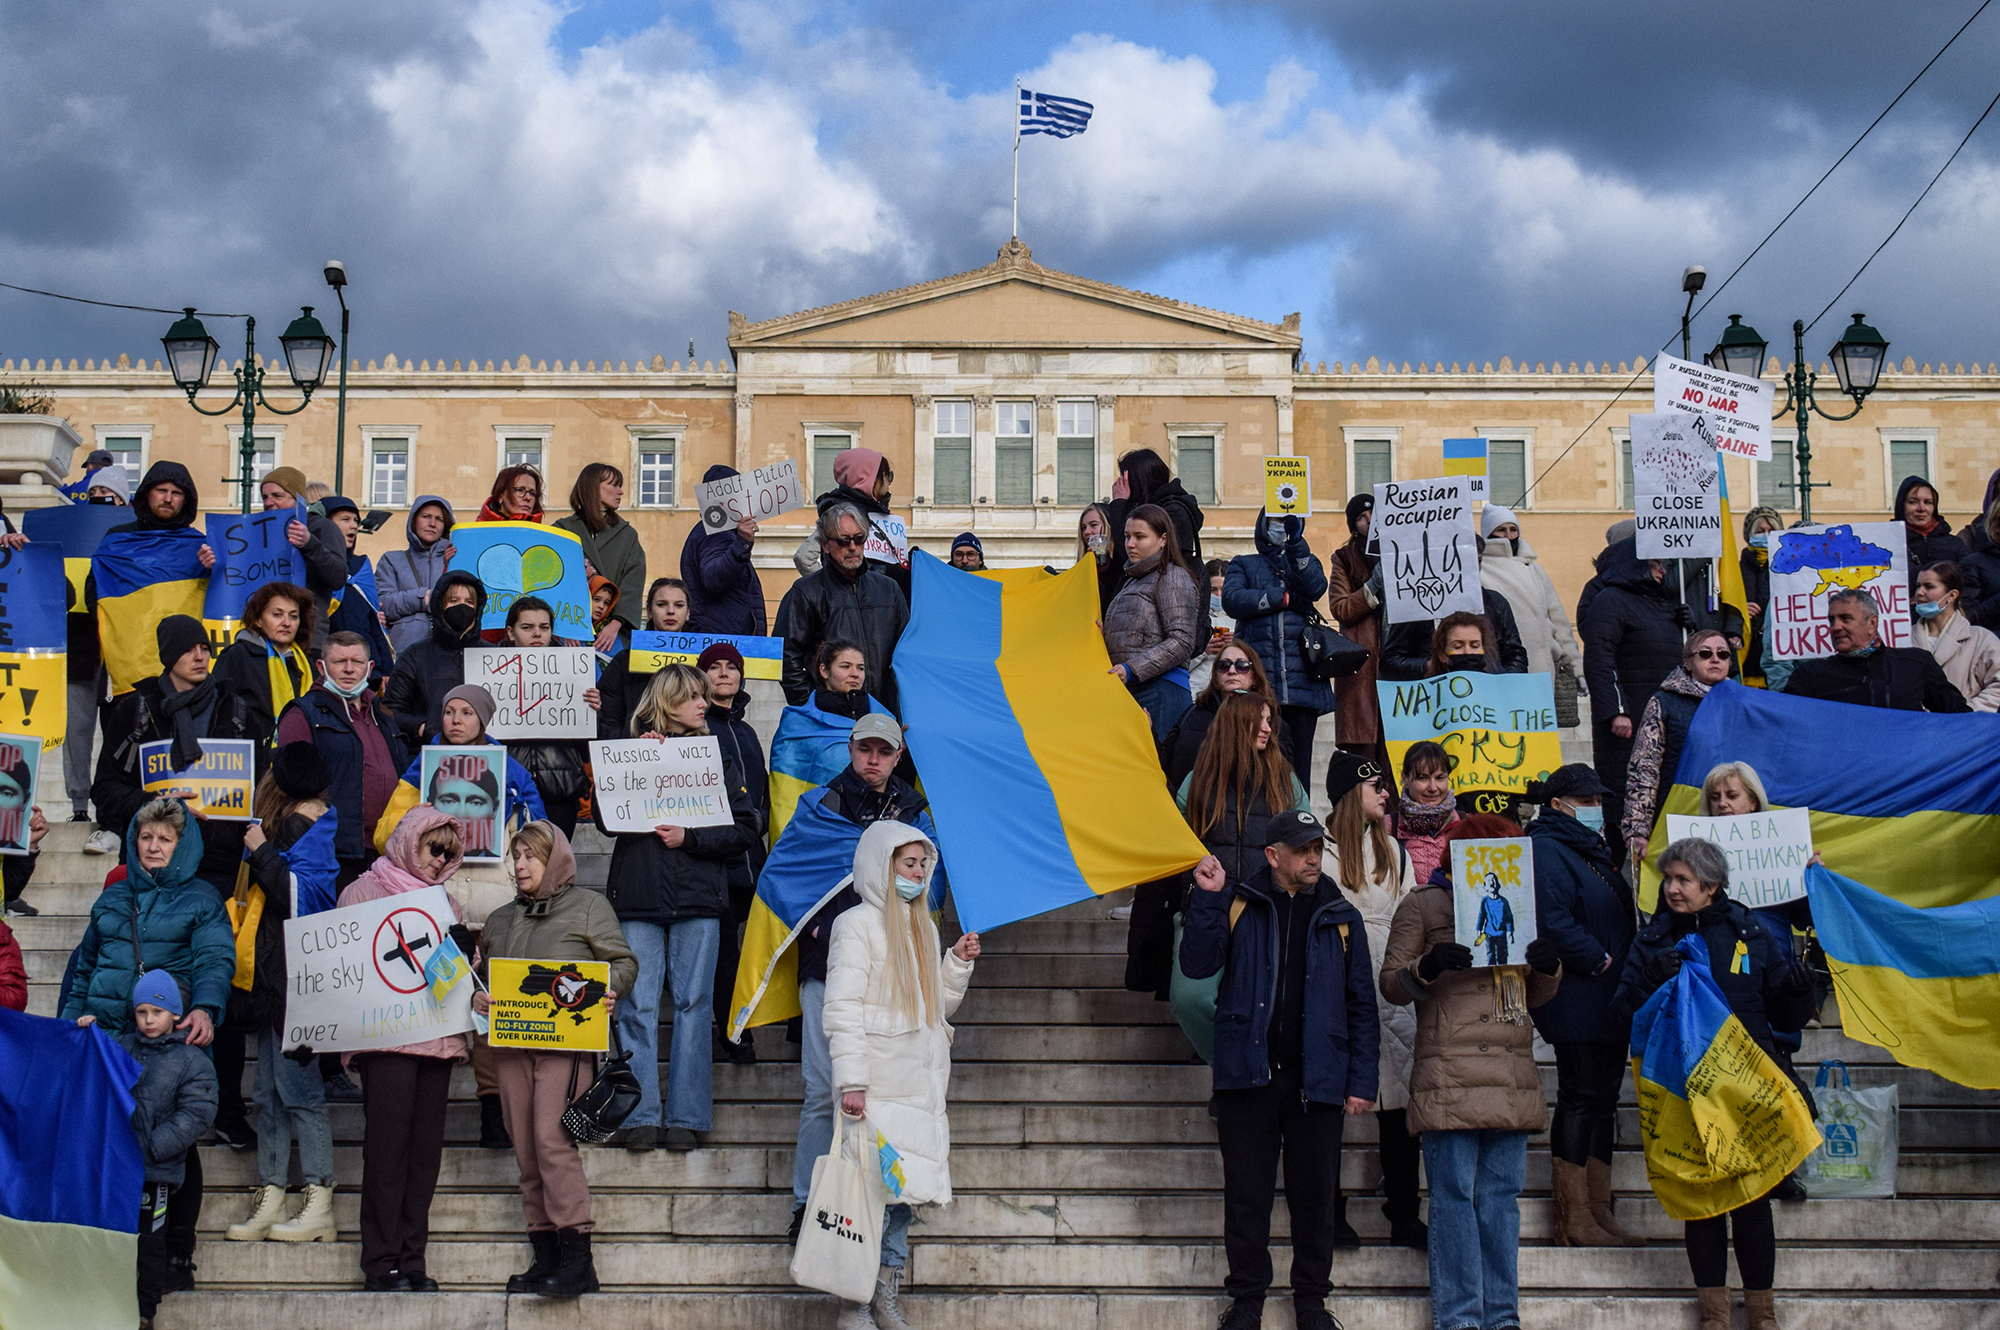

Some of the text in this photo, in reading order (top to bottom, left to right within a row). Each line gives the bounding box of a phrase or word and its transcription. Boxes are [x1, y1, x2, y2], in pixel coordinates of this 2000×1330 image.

[1678, 365, 1702, 378] RUSSIA
[1703, 373, 1725, 385] STOPS
[1726, 379, 1759, 394] FIGHTING
[1689, 378, 1739, 397] THERE WILL BE
[1682, 387, 1738, 414] NO WAR
[1728, 416, 1760, 431] FIGHTING
[1716, 435, 1759, 457] RAINE
[1267, 460, 1301, 468] СЛАВА
[1267, 469, 1306, 477] УКРАЇНІ
[706, 476, 743, 499] Adolf
[1385, 483, 1458, 509] Russian
[1652, 496, 1704, 510] CLOSE
[1385, 506, 1462, 528] occupier
[1636, 515, 1720, 530] UKRAINIAN
[1663, 534, 1694, 548] SKY
[654, 635, 697, 649] STOP
[1392, 675, 1473, 718] NATO
[1432, 703, 1553, 730] CLOSE THE
[601, 745, 711, 764] Russia's war
[1441, 730, 1526, 770] SKY
[438, 754, 489, 781] STOP
[599, 767, 719, 798] is the genocide
[201, 786, 244, 808] WAR
[616, 800, 631, 820] of
[1465, 844, 1522, 867] STOP
[297, 957, 364, 995] the sky
[497, 1000, 548, 1009] INTRODUCE
[291, 1023, 338, 1043] over
[497, 1021, 554, 1031] NO-FLY ZONE
[497, 1032, 564, 1042] OVER UKRAINE!
[837, 1226, 866, 1243] KYIV
